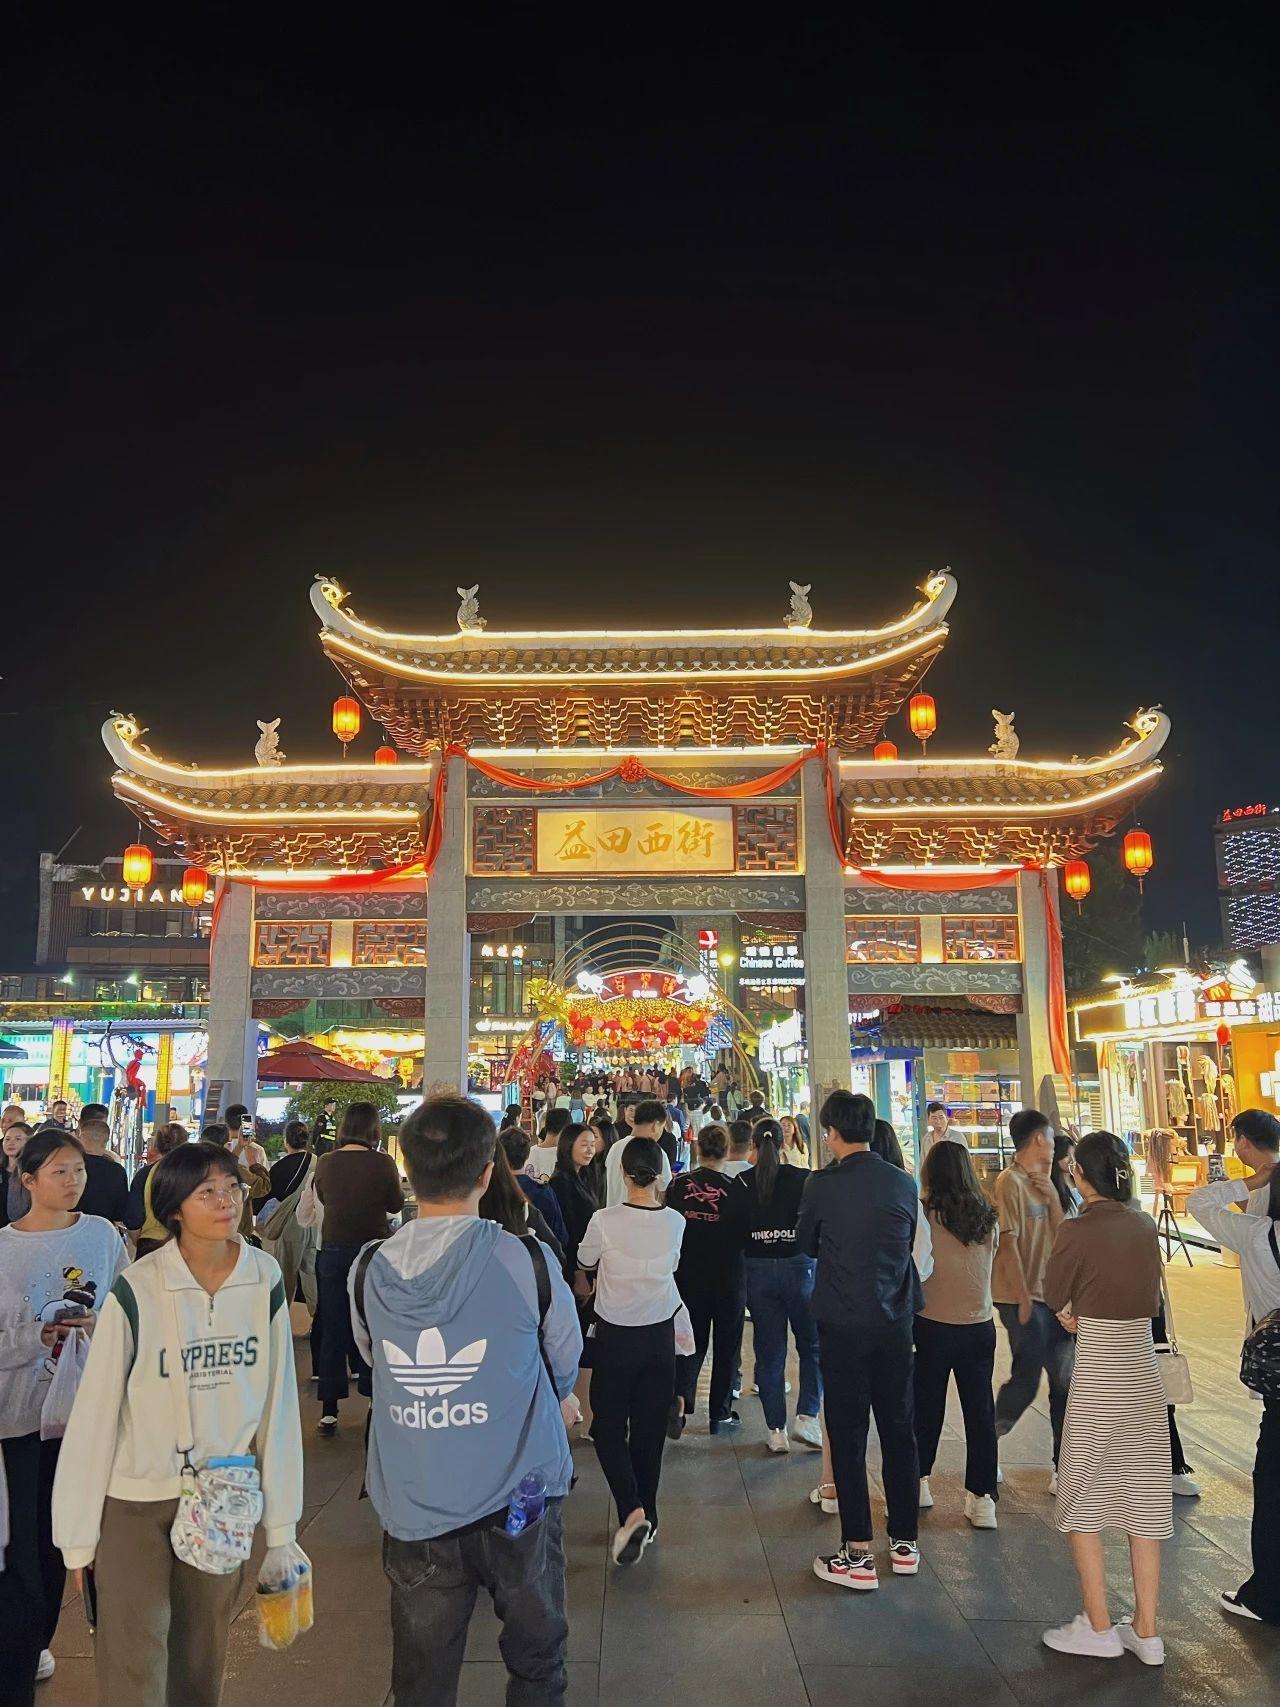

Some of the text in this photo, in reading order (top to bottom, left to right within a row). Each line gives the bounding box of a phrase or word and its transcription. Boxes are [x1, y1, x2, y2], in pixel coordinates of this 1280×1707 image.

[1222, 803, 1266, 822] 益田西街
[554, 820, 715, 861] 益田西街
[740, 956, 805, 969] Chinese Coffee
[389, 1399, 489, 1430] adidas
